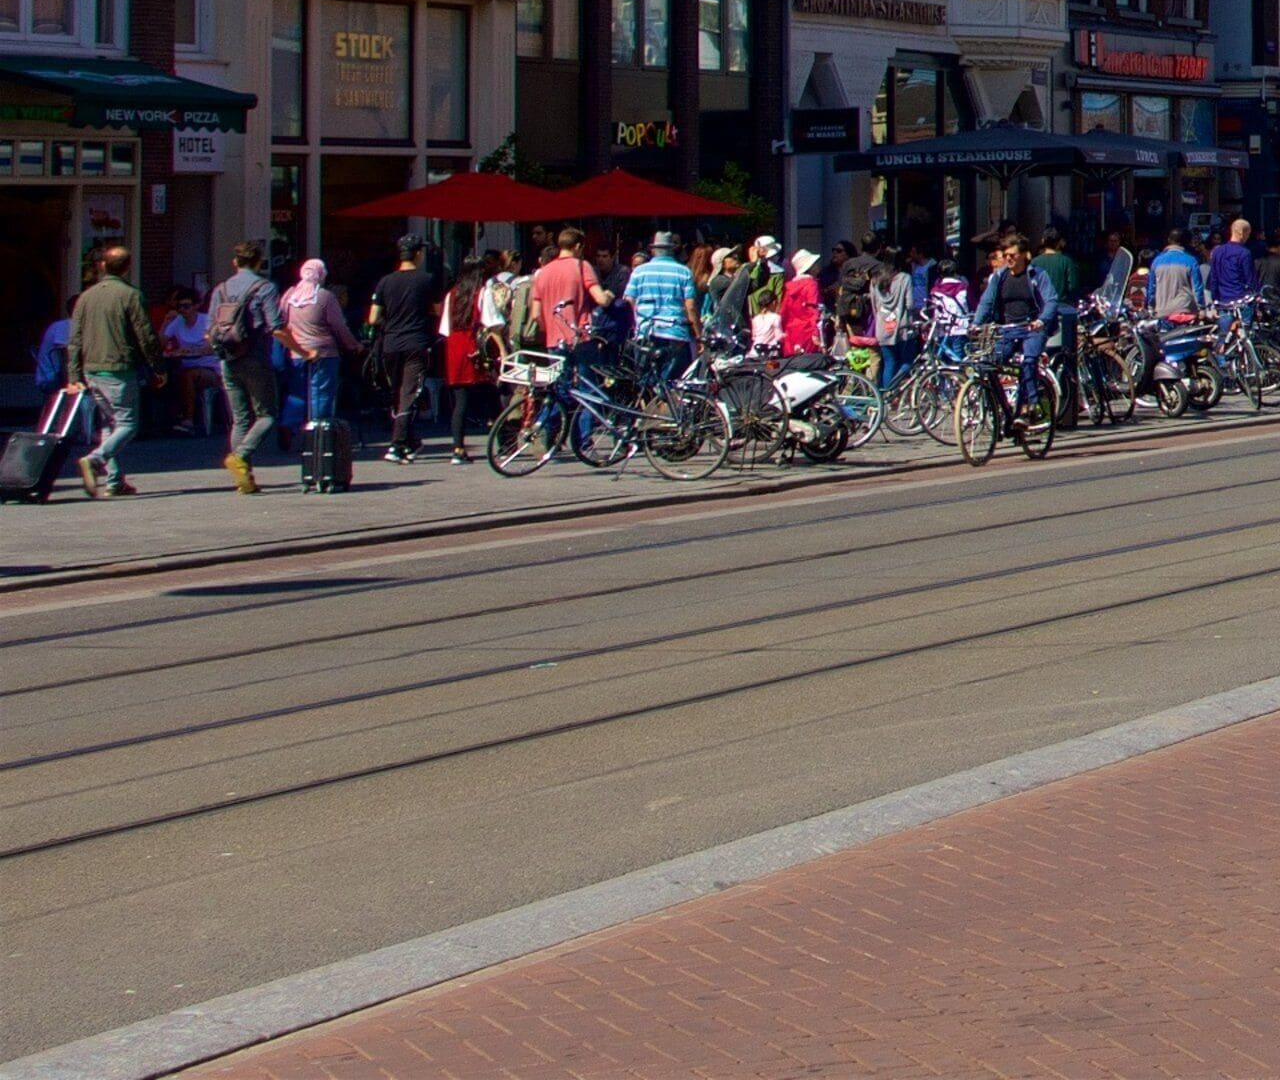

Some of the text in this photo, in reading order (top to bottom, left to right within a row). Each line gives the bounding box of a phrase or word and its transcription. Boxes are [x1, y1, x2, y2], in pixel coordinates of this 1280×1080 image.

[335, 31, 395, 60] STOCK
[105, 108, 220, 125] NEW YORK PIZZA
[178, 137, 216, 153] HOTEL
[875, 150, 1033, 167] LUNCH & STEAKHOUSE
